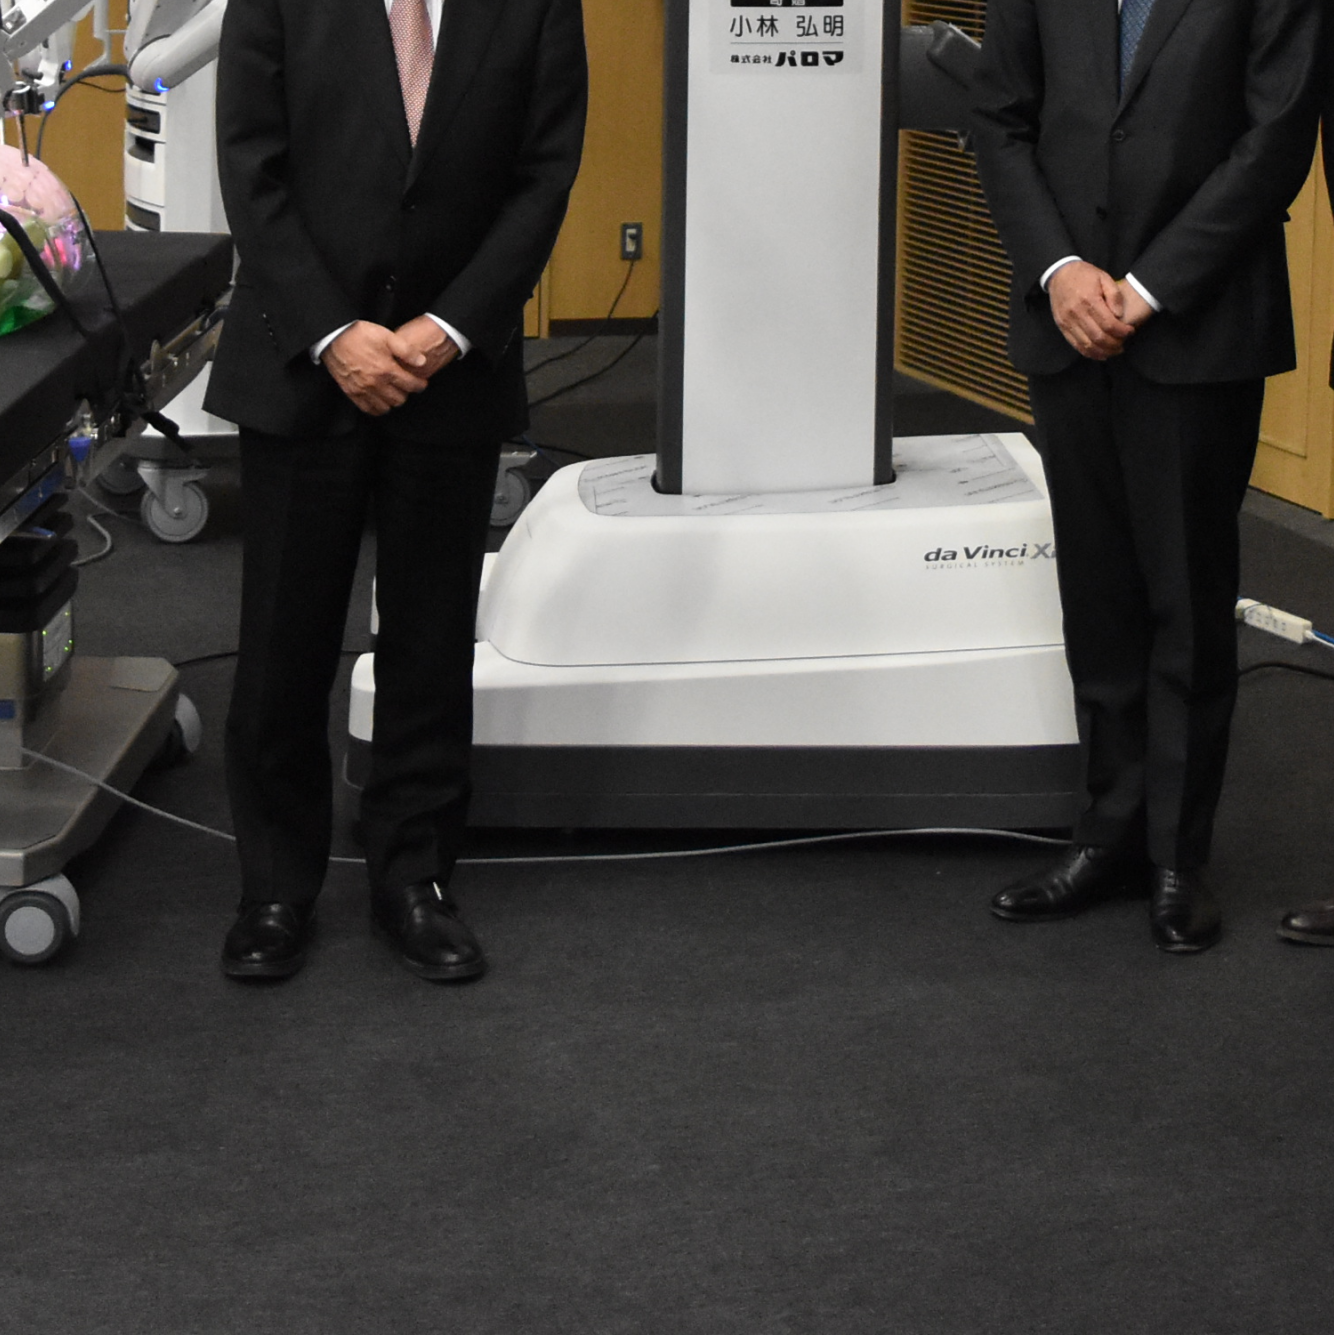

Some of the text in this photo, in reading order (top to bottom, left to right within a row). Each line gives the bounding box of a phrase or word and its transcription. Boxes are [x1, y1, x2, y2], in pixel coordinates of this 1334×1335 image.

[730, 15, 844, 37] 小林 弘明
[730, 50, 844, 67] 株式会社 パロマ
[923, 547, 958, 562] da
[963, 543, 1027, 560] Vinci
[925, 560, 1025, 570] SURGICAL SYSTEM
